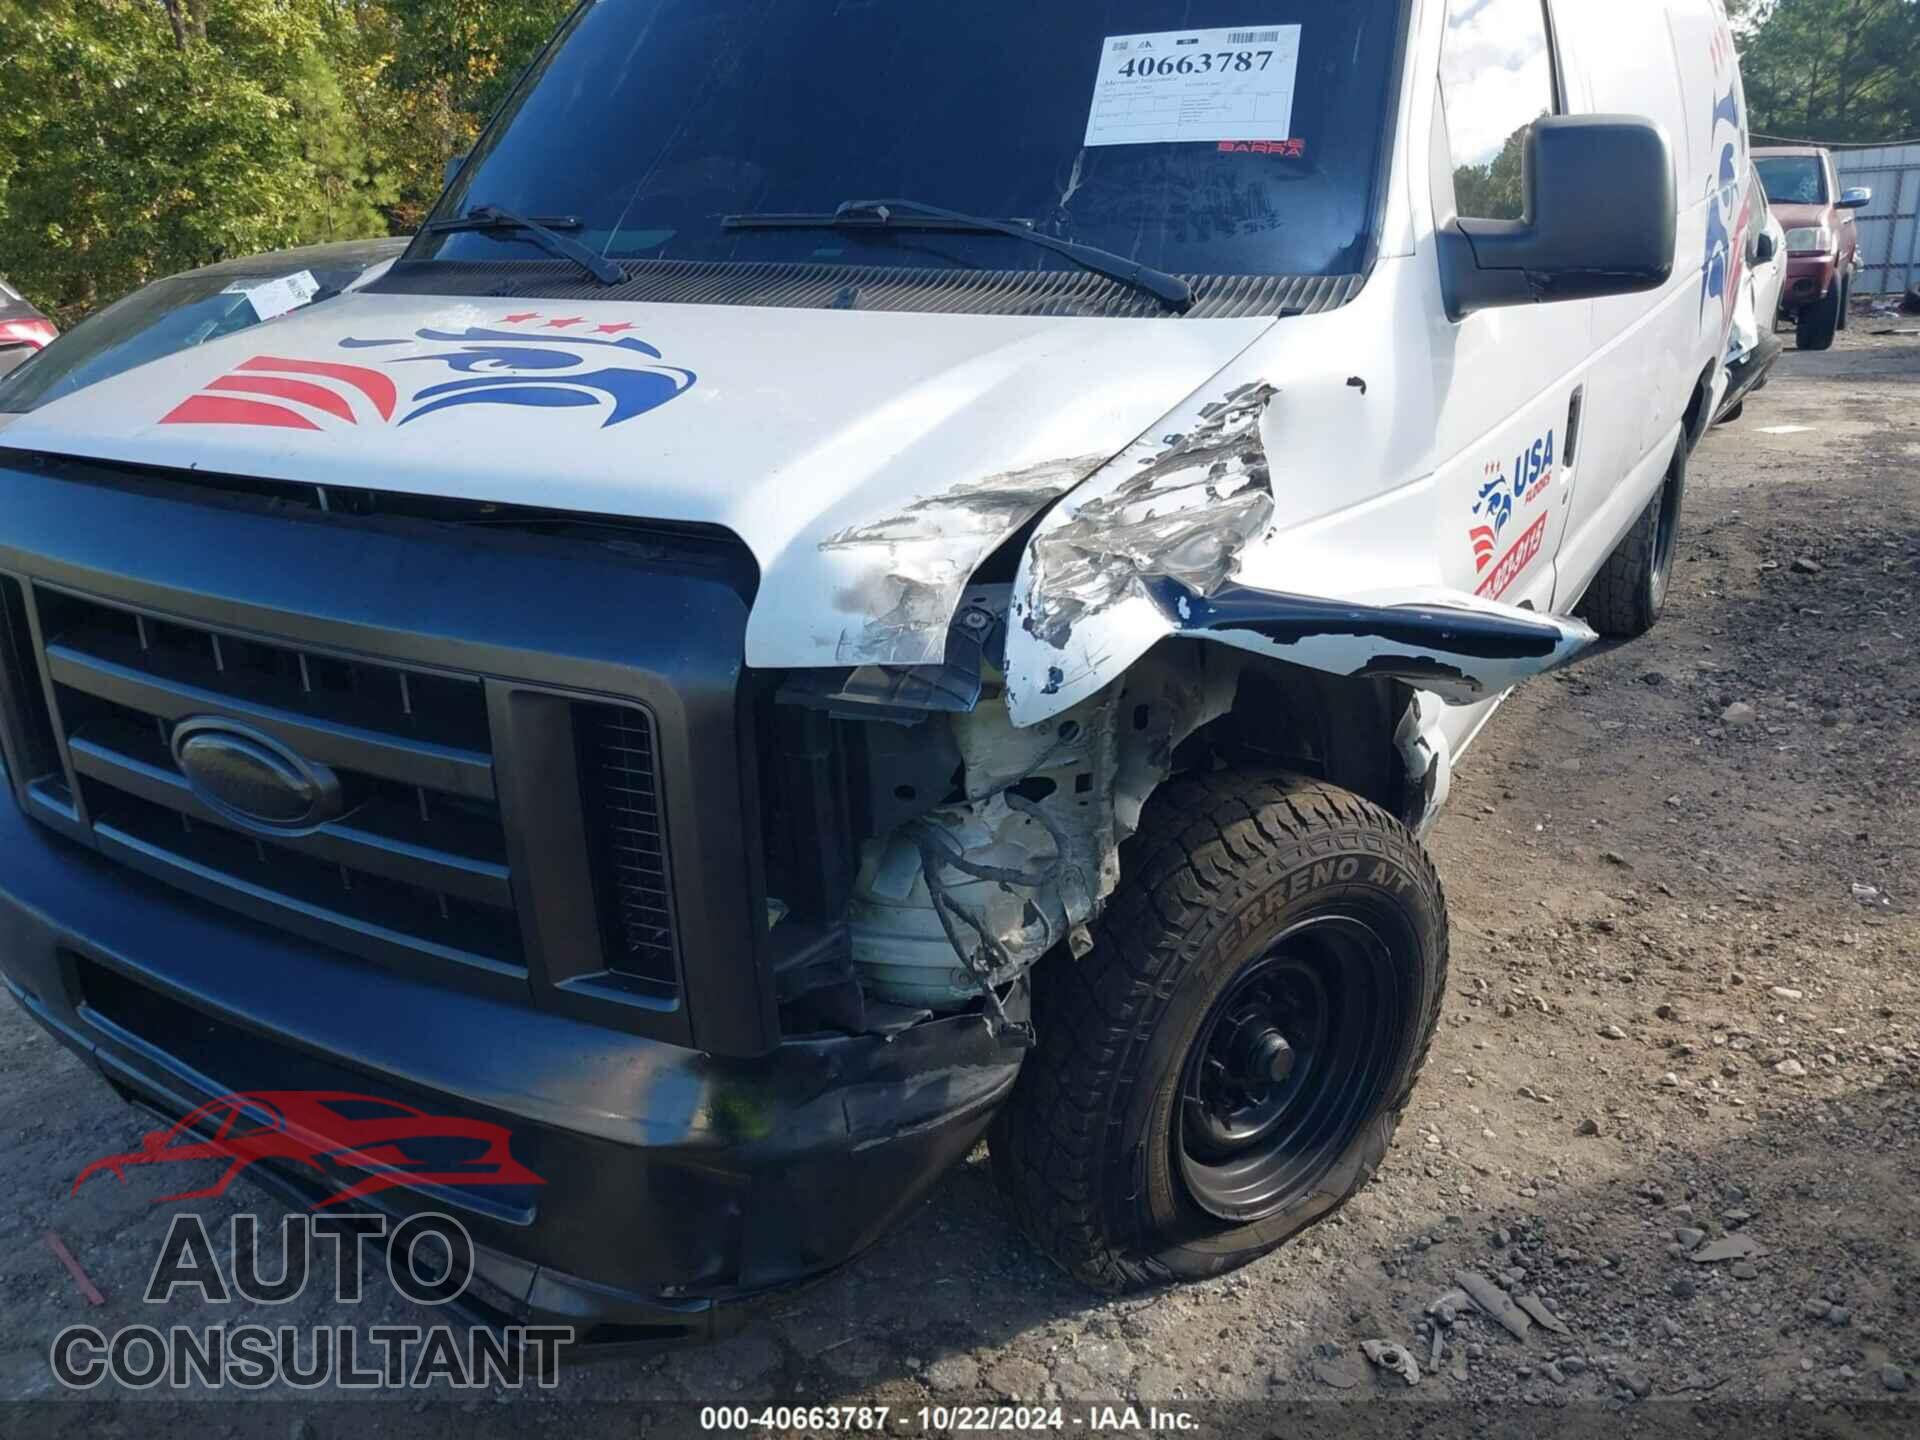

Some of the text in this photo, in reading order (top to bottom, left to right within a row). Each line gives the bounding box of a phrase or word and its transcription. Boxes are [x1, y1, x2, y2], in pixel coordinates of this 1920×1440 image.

[1117, 50, 1273, 78] 40663787
[1513, 428, 1553, 498] USA
[1207, 857, 1360, 968] ERRENO
